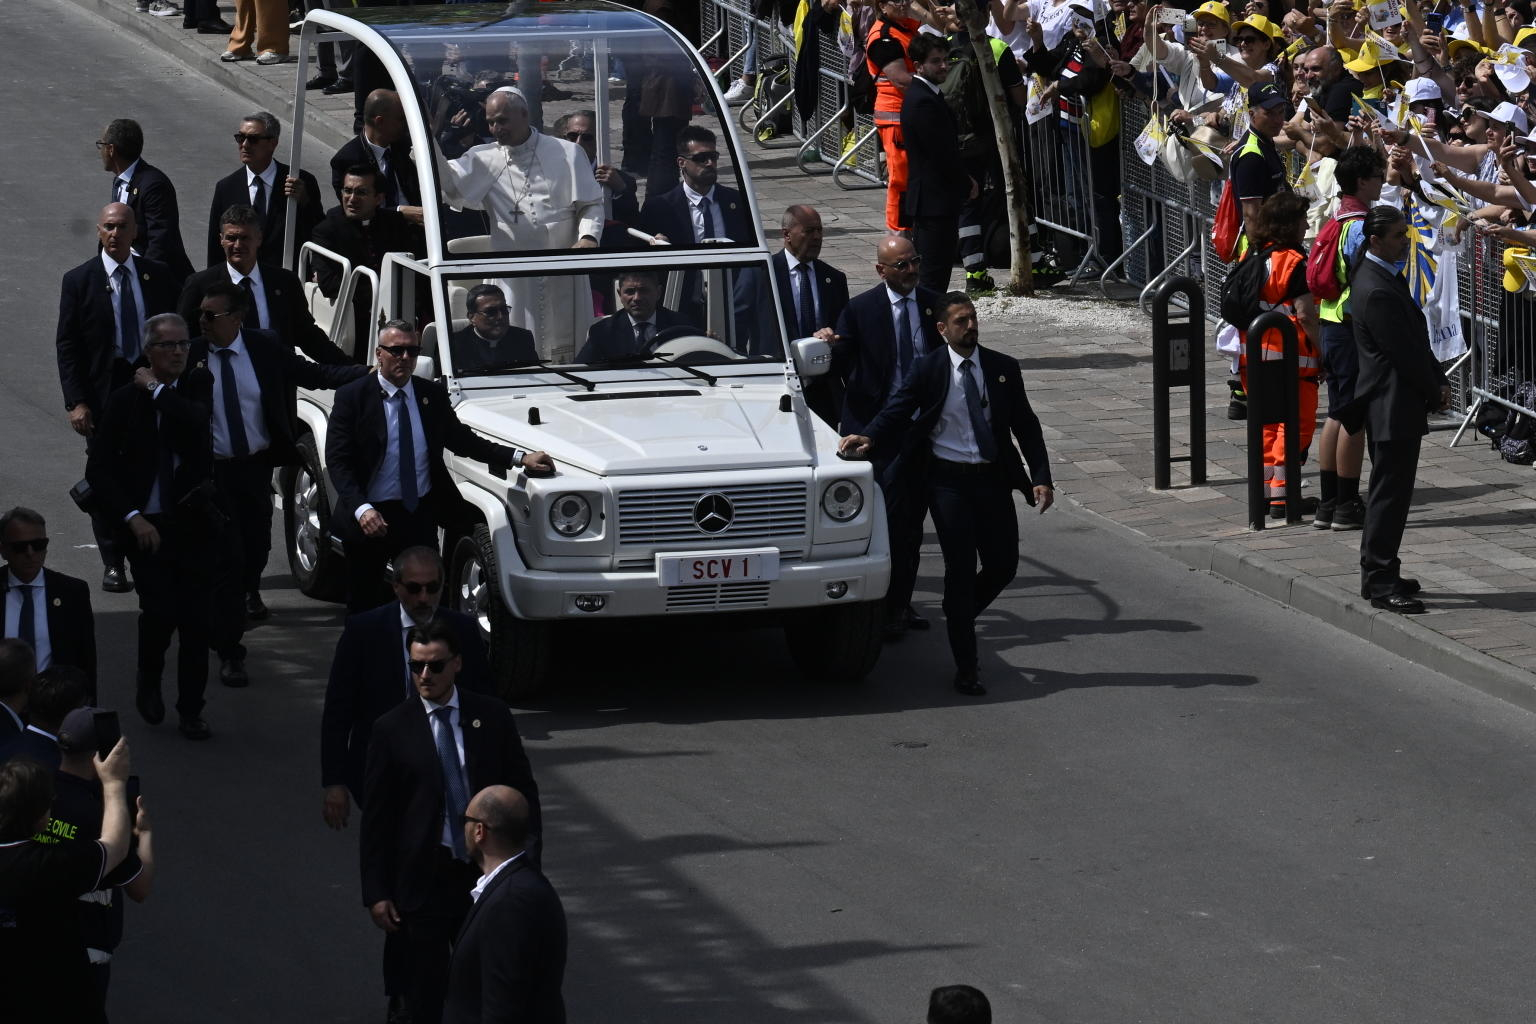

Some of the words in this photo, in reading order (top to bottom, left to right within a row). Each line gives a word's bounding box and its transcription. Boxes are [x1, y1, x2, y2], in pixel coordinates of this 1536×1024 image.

[692, 559, 732, 580] SCV
[742, 557, 749, 577] 1
[52, 819, 78, 840] CIVILE
